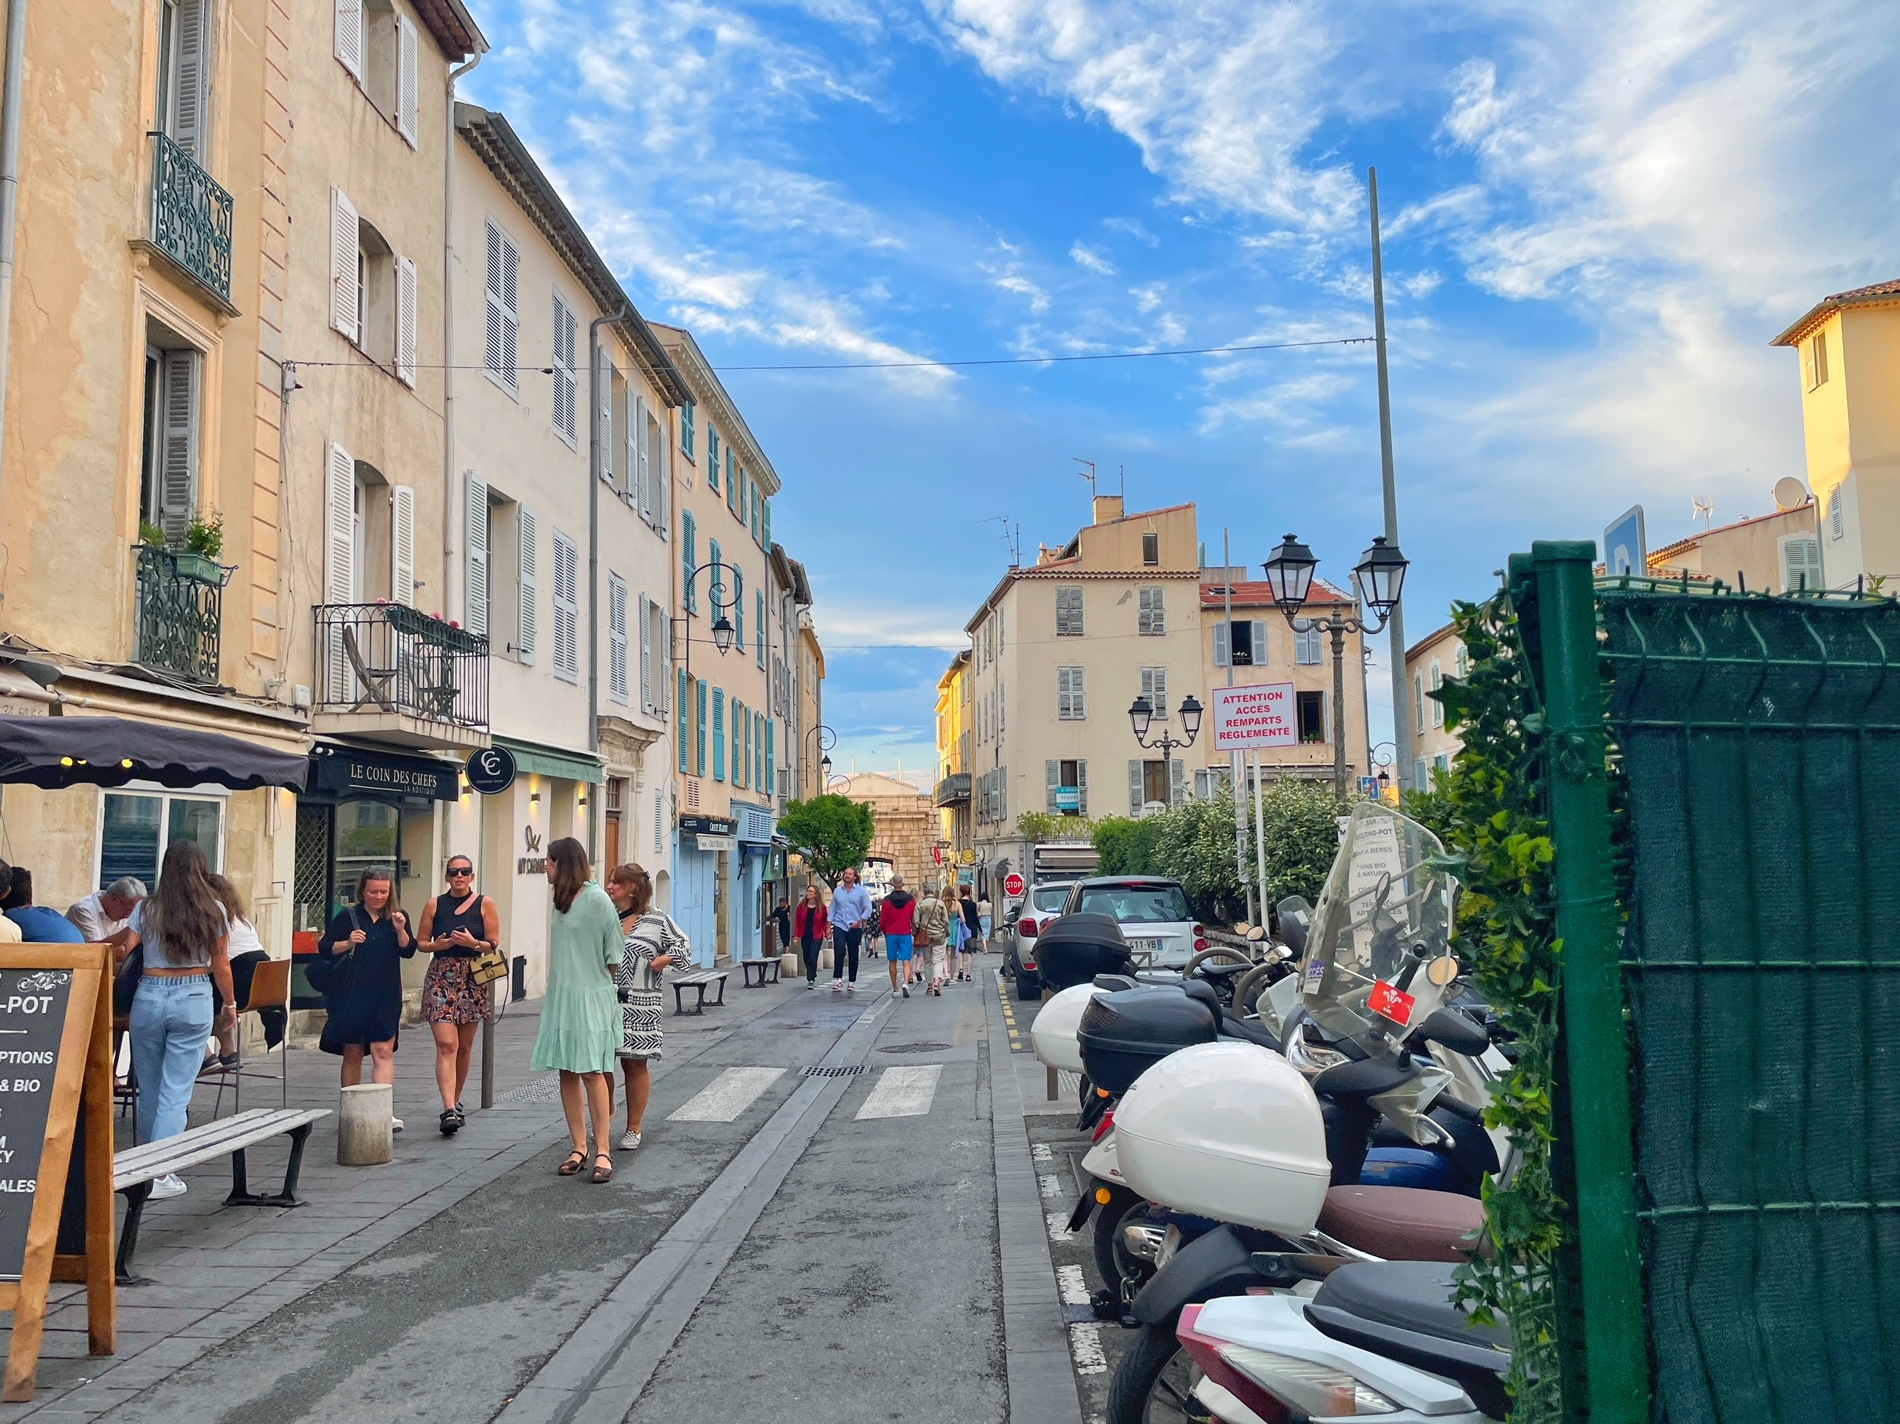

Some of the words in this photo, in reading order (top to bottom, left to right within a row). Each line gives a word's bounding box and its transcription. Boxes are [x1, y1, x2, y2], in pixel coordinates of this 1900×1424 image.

[1223, 692, 1283, 704] ATTENTION
[1236, 704, 1271, 715] ACCÈS
[1226, 716, 1282, 728] REMPARTS
[1219, 726, 1290, 740] RÉGLEMENTÉ
[350, 764, 363, 779] LE
[366, 766, 390, 782] COIN
[393, 769, 410, 784] DES
[411, 772, 437, 788] CHEFS
[1006, 881, 1022, 889] STOP
[0, 1079, 9, 1092] &
[13, 1079, 41, 1093] BIO
[0, 1180, 36, 1193] ALES
